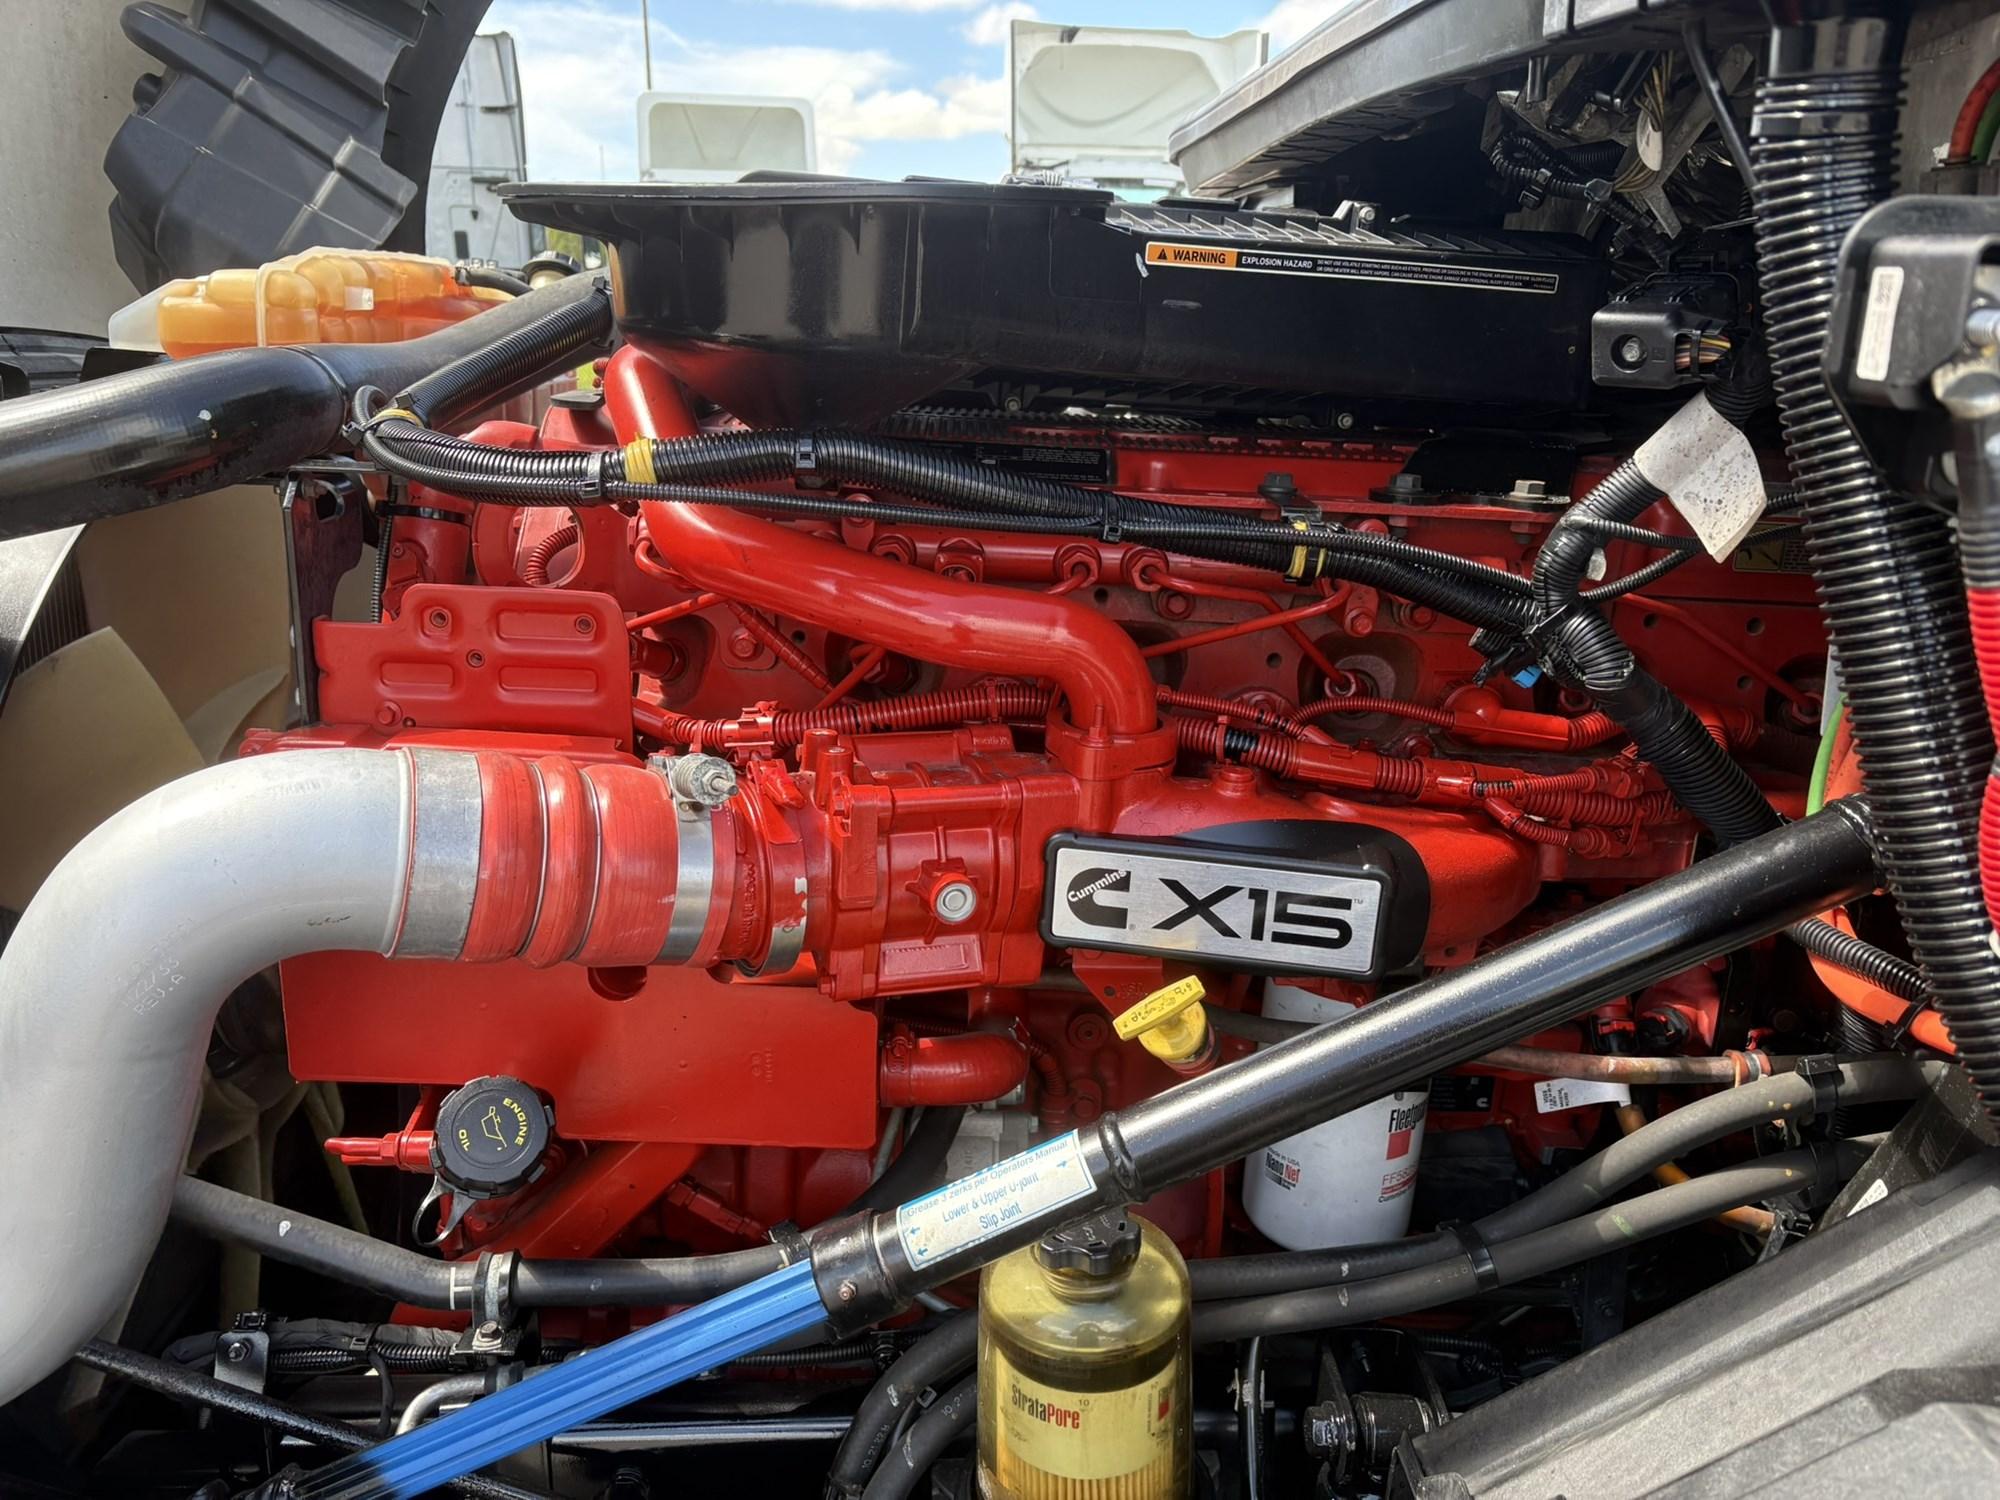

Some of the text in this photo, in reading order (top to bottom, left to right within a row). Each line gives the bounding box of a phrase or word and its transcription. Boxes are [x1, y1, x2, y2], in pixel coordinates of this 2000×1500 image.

[1173, 249, 1226, 264] WARNING
[1242, 256, 1313, 268] EXPLOSION HAZARD
[1068, 868, 1127, 903] Cummins
[1152, 877, 1353, 950] X15
[502, 1098, 528, 1146] ENGINE
[458, 1128, 472, 1152] OIL
[908, 1196, 940, 1217] Grease
[942, 1192, 948, 1202] 3
[950, 1182, 973, 1198] zerks
[974, 1176, 988, 1192] per
[990, 1154, 1034, 1181] Operators
[1036, 1140, 1068, 1162] Manual
[942, 1202, 970, 1222] Lower
[972, 1198, 980, 1210] &
[981, 1186, 1008, 1206] Upper
[979, 1202, 1022, 1232] Slip Joint
[1012, 1384, 1080, 1430] StrataPore
